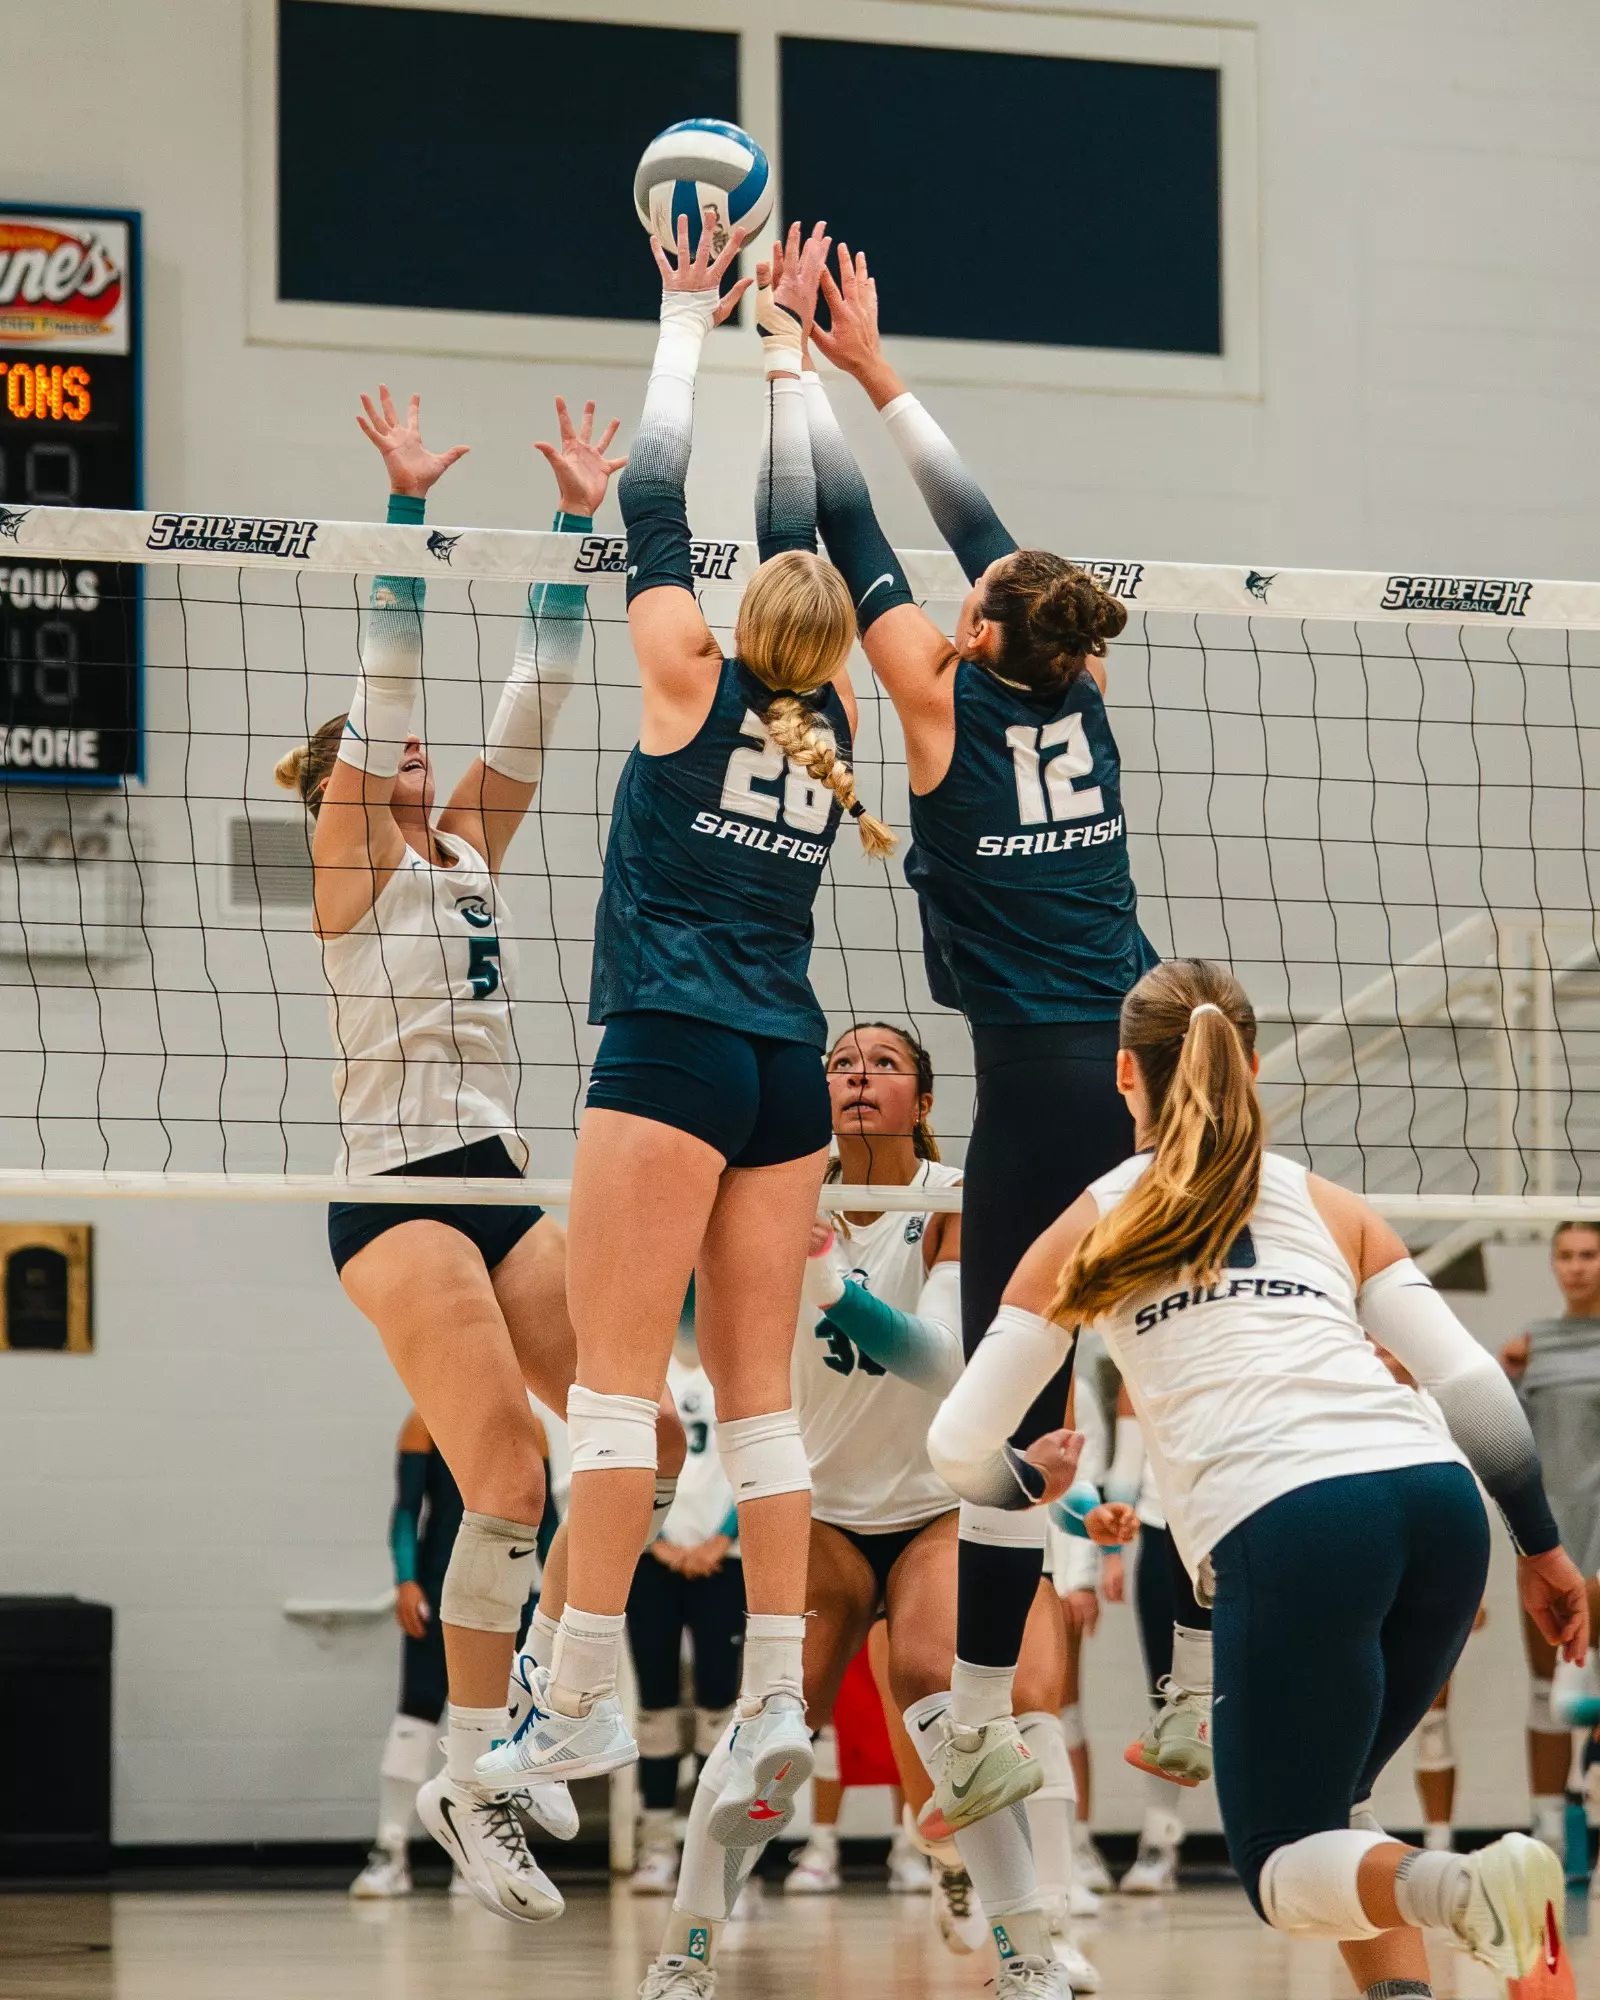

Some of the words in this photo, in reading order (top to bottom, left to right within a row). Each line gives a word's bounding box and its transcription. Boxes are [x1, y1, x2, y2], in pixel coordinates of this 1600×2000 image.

[146, 514, 319, 558] SAILFISH
[174, 537, 276, 554] VOLLEYBALL
[574, 536, 740, 580] SASH
[1380, 576, 1533, 616] SAILFISH
[1406, 597, 1495, 612] VOLLEYBALL
[1005, 712, 1105, 826] 12
[690, 811, 829, 866] SAILFISH
[976, 814, 1122, 857] SAILFISH
[466, 936, 499, 1001] 5
[815, 1317, 887, 1377] 3
